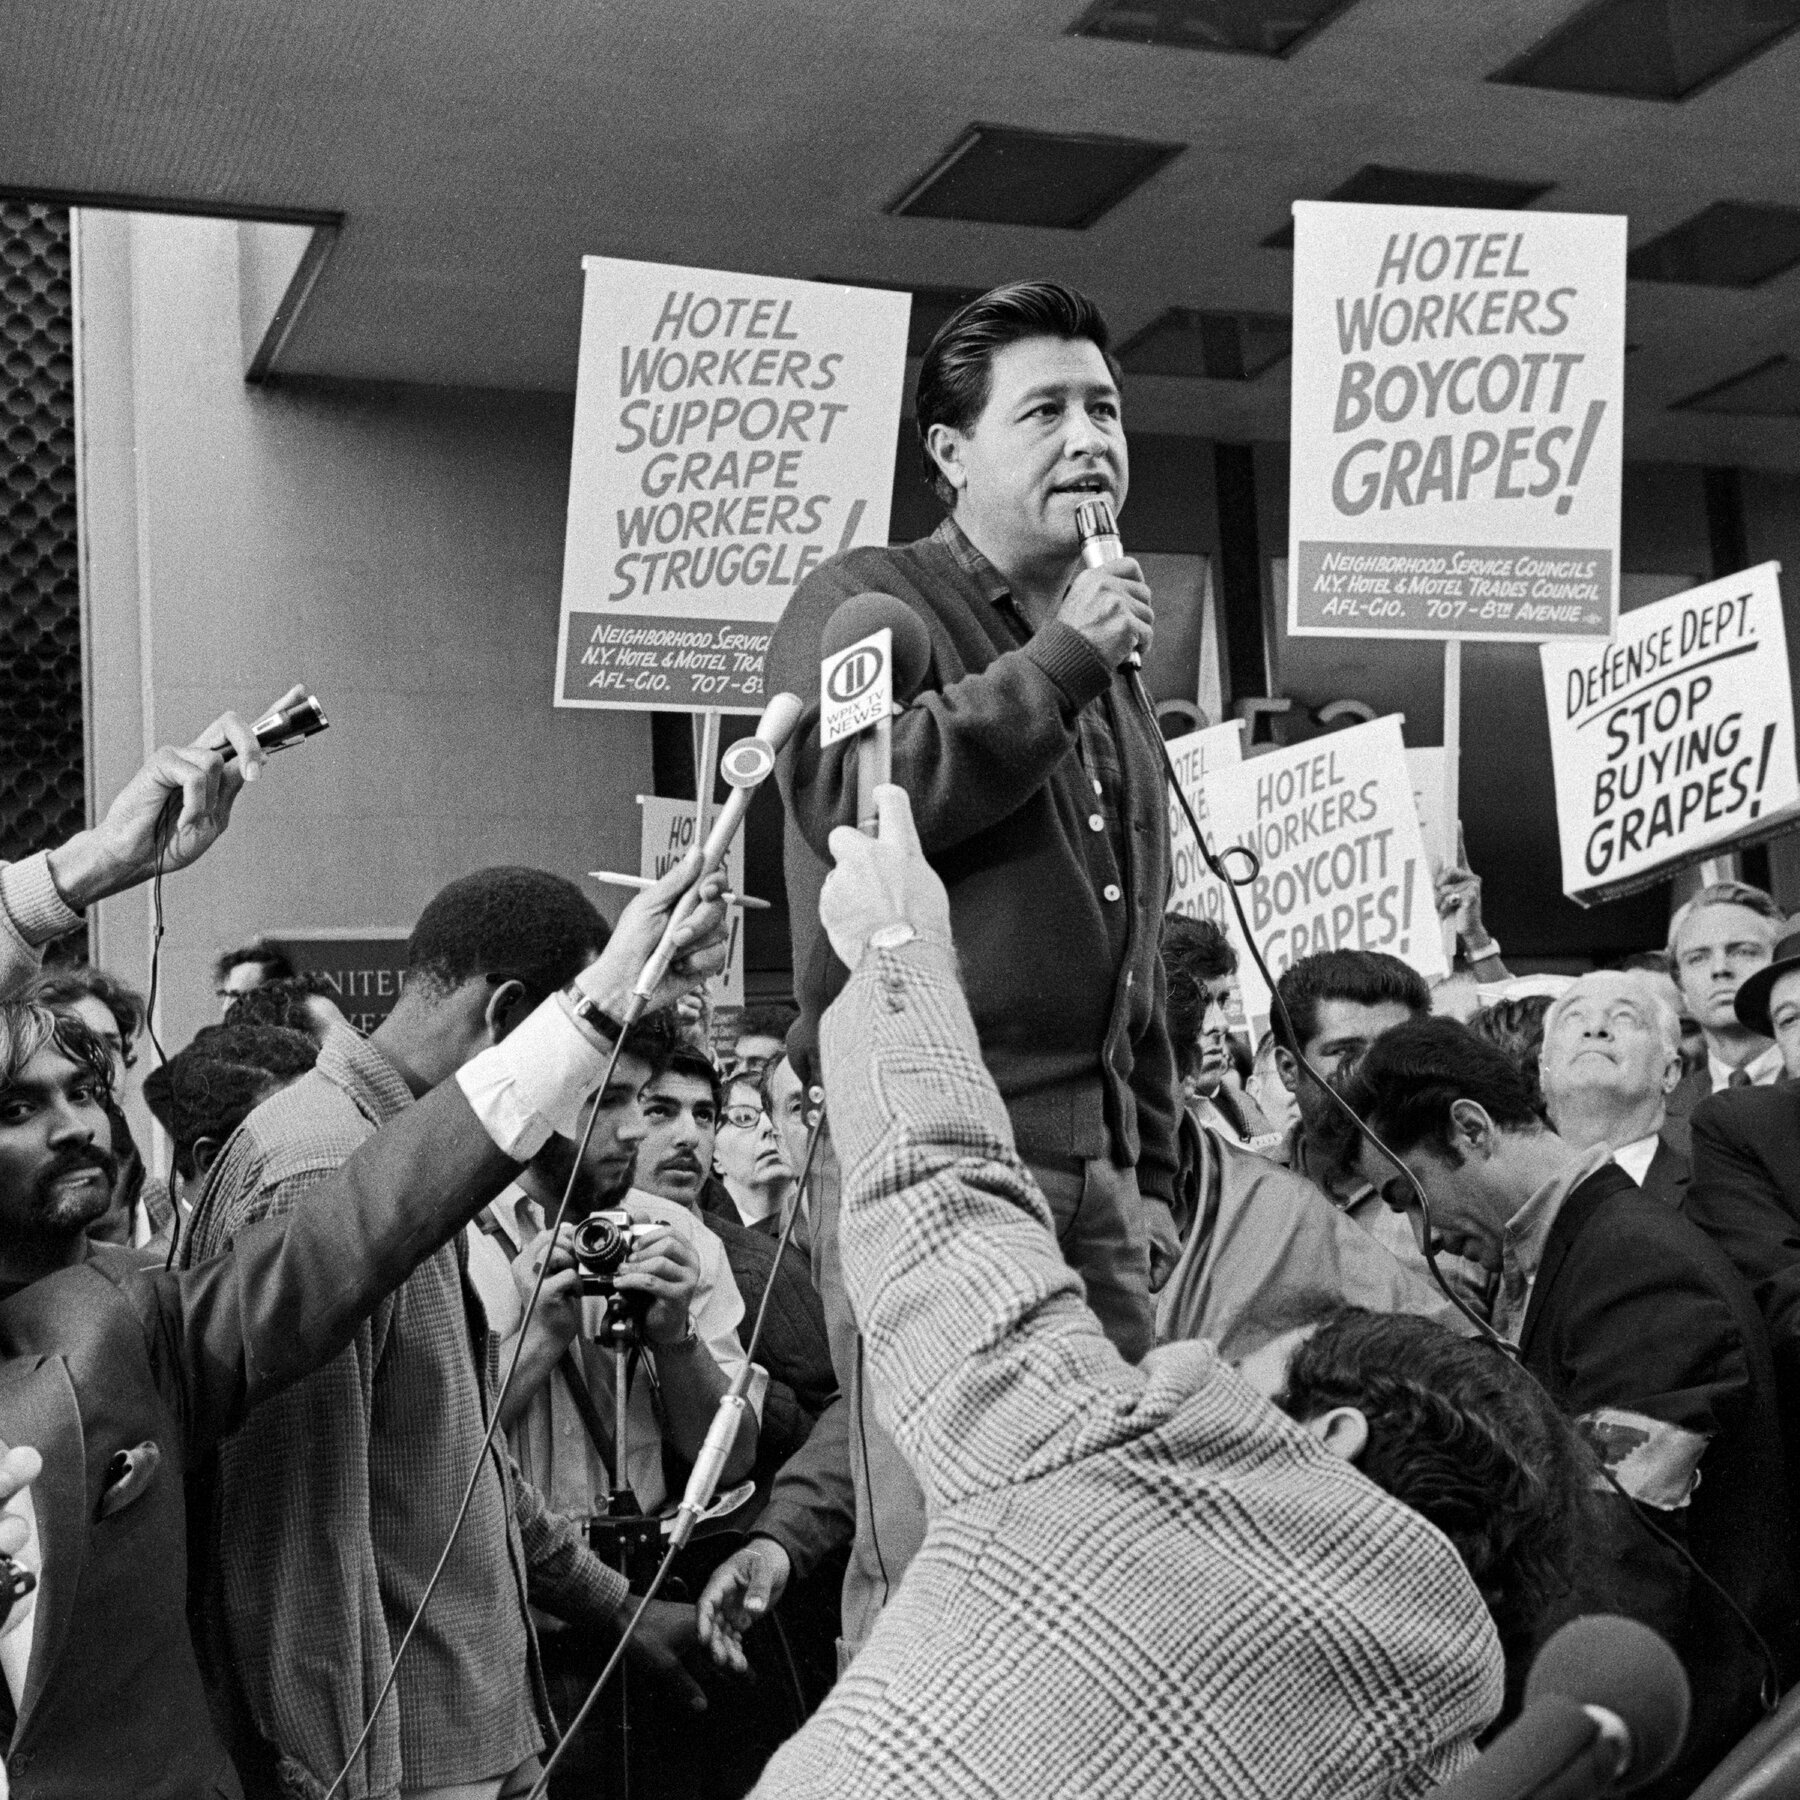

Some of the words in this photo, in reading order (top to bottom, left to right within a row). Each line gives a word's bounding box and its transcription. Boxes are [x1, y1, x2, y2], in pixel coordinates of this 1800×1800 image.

[1375, 232, 1530, 289] HOTEL
[652, 291, 799, 342] HOTEL
[1335, 287, 1577, 355] WORKERS
[619, 346, 843, 397] WORKERS
[1333, 353, 1585, 433] BOYCOTT
[615, 398, 849, 454] SUPPORT
[640, 450, 802, 498] GRAPE
[1332, 400, 1607, 516] GRAPES!
[616, 495, 831, 549] WORKERS
[1321, 552, 1446, 574] NEIGHBORHOOD
[1446, 550, 1513, 576] SERVICE
[1515, 556, 1597, 579] COUNCILS
[1347, 575, 1391, 594] HOTEL
[1394, 577, 1407, 594] &
[1407, 575, 1463, 596] MOTEL
[1469, 577, 1529, 598] TRADES
[1531, 578, 1599, 600] COUNCIL
[591, 624, 712, 649] NEIGHBORHOOD
[1515, 602, 1583, 622] AVENUE
[1680, 592, 1756, 658] DEPT.
[615, 648, 658, 667] HOTEL
[661, 651, 674, 668] &
[674, 650, 727, 671] MOTEL
[732, 652, 764, 672] TRA
[826, 703, 860, 726] WPIX
[829, 703, 882, 739] NEWS
[1606, 675, 1713, 762] STOP
[1174, 745, 1209, 787] OTEL
[1257, 750, 1345, 821] HOTEL
[1593, 712, 1743, 818] BUYING
[1585, 722, 1777, 877] GRAPES!
[1237, 780, 1379, 874] WORKERS
[1251, 827, 1394, 932] BOYCOTT
[311, 969, 406, 996] NITE
